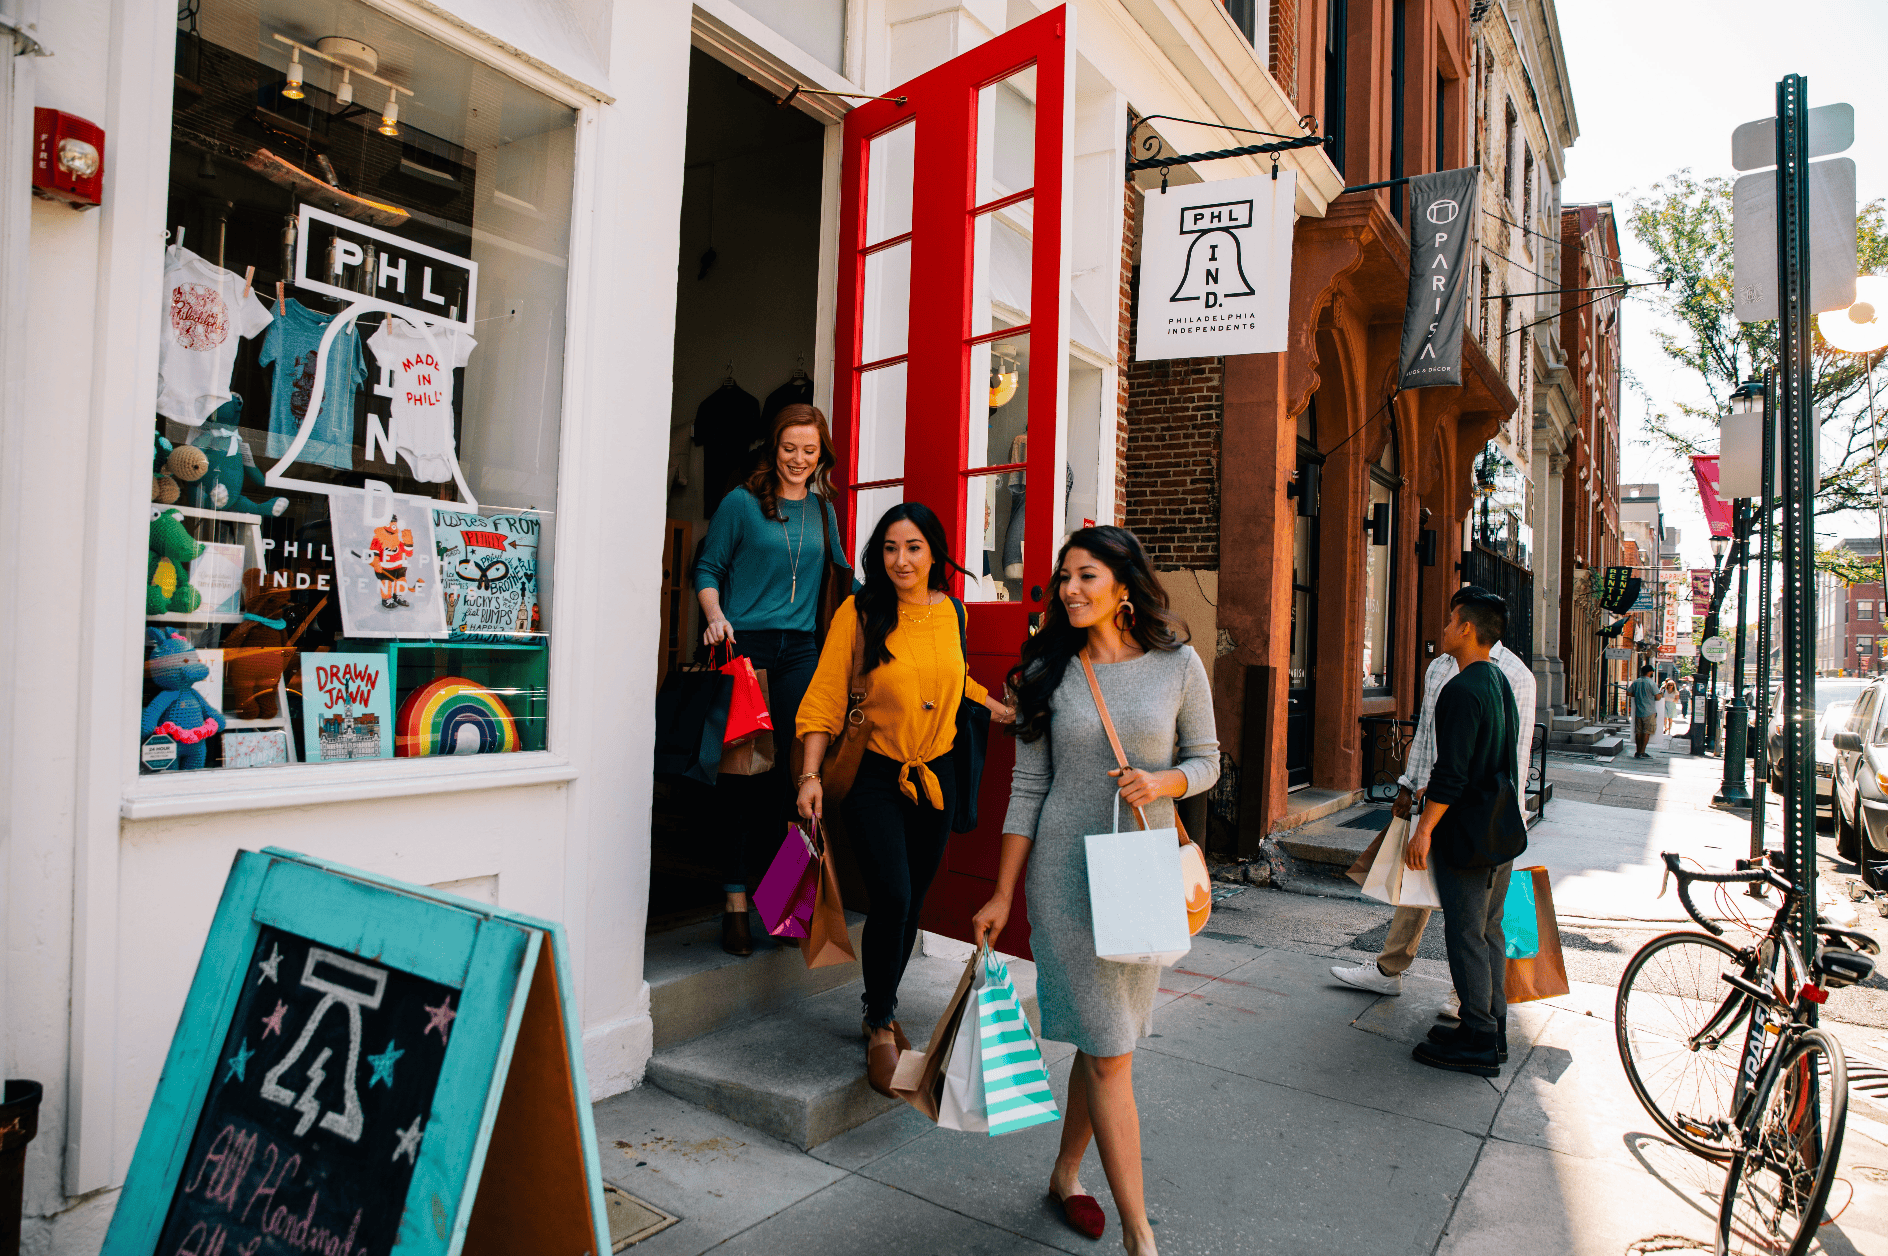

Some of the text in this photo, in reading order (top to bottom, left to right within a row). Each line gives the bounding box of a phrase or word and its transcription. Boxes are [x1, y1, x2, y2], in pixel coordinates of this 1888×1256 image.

[38, 133, 49, 169] FIRE
[1192, 208, 1239, 226] PHL
[334, 239, 446, 306] PHL
[1167, 312, 1256, 325] PHILADELPHIA
[1167, 322, 1256, 335] INDEPENDENTS
[417, 374, 432, 386] IN
[406, 390, 443, 407] PHILL
[492, 517, 541, 536] FROM
[261, 538, 478, 573] PHILADELPHIA
[1603, 568, 1617, 608] RENTAL
[481, 609, 513, 626] BUMPS
[1665, 619, 1675, 644] SHOP
[315, 662, 380, 692] DRAWN
[323, 684, 372, 709] JAWN
